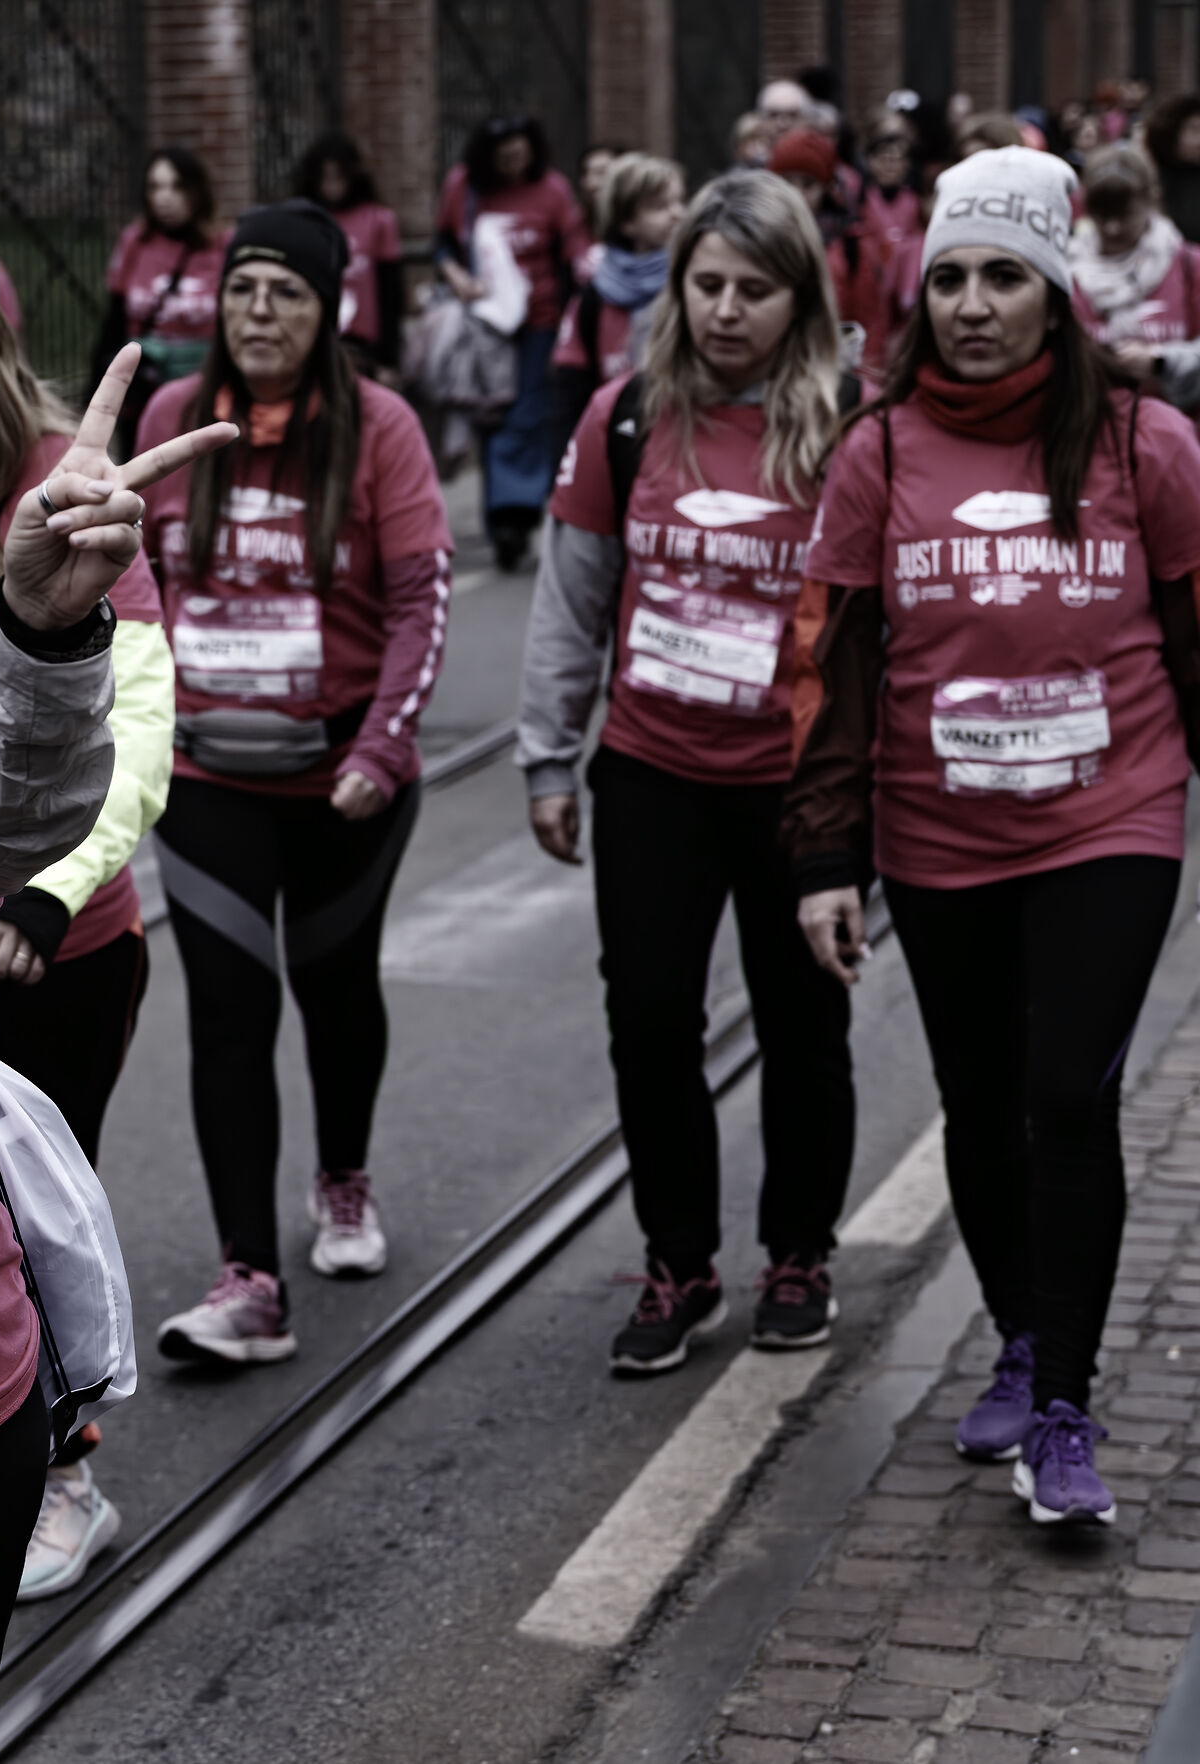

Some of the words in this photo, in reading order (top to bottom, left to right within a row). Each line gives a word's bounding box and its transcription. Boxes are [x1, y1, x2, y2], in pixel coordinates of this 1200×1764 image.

[946, 192, 1069, 256] adida
[626, 518, 661, 556] UST
[665, 525, 701, 560] THE
[703, 529, 774, 569] WOMAN
[894, 539, 942, 579] JUST
[949, 536, 992, 575] THE
[996, 535, 1078, 575] WOMAN
[1084, 538, 1095, 576] I
[1098, 540, 1126, 577] AM
[938, 728, 1040, 748] VANZETTI
